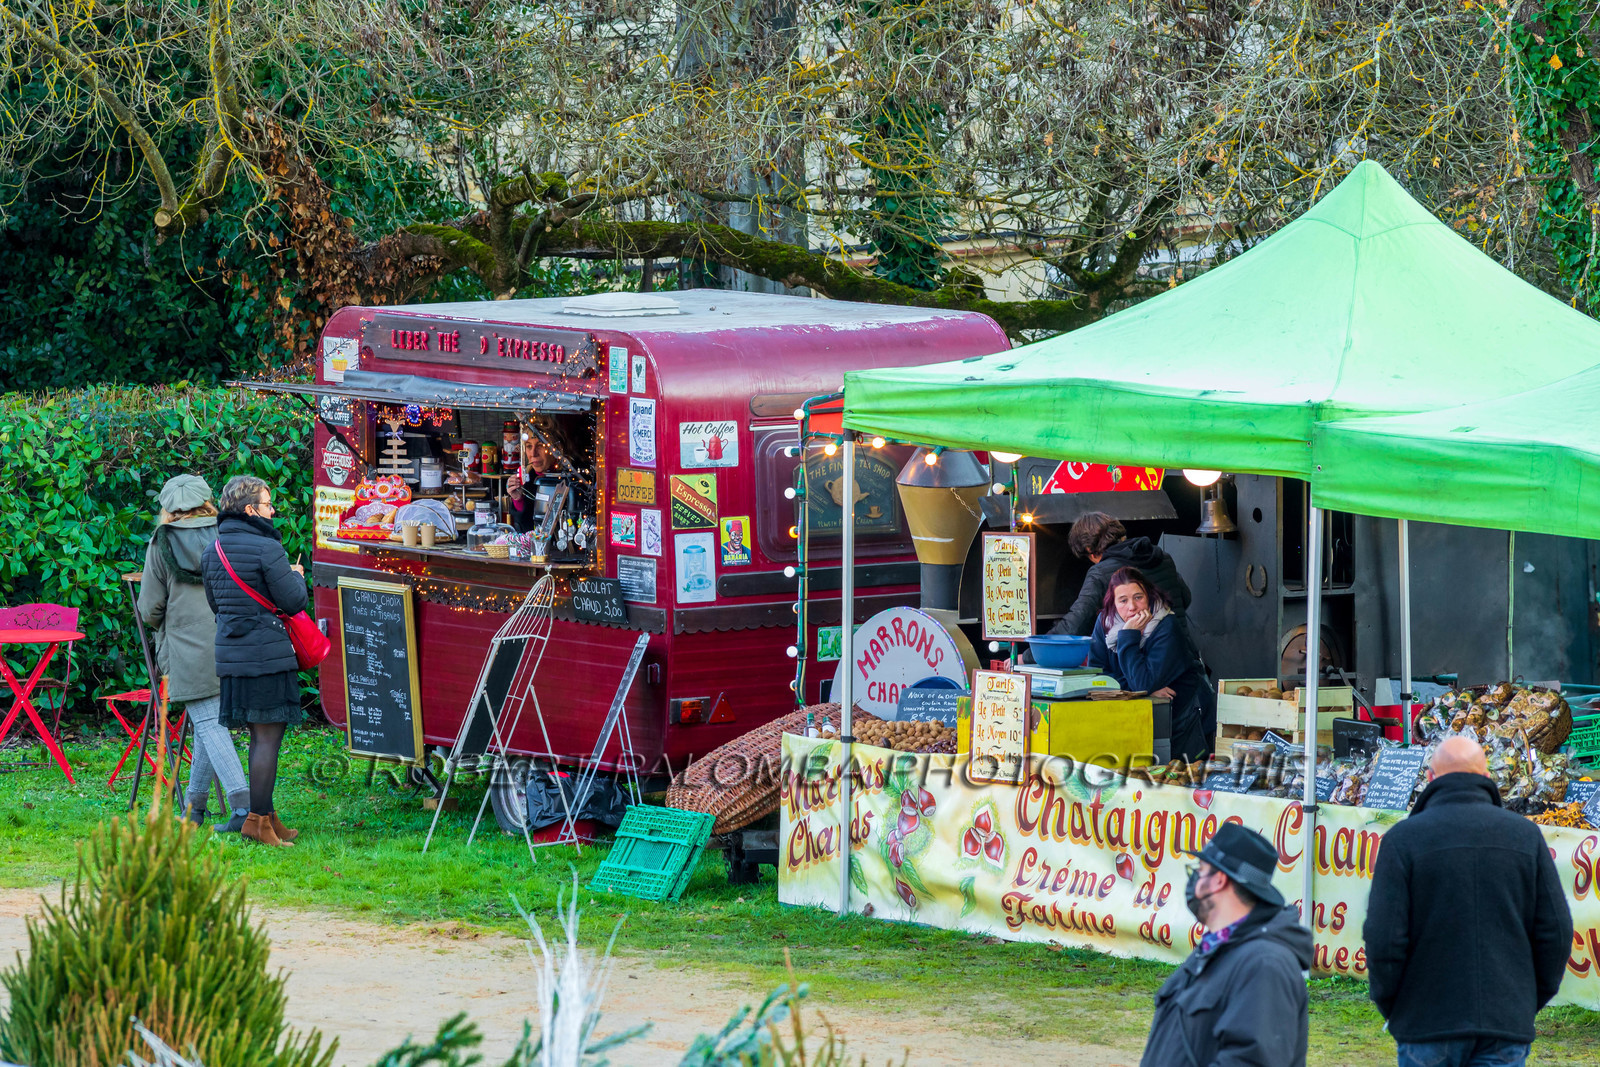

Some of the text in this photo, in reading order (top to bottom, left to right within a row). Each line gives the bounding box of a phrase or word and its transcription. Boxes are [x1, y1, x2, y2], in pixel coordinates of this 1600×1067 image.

[683, 422, 735, 439] Hot Coffee
[809, 466, 826, 480] THE
[873, 464, 890, 478] SHOP
[619, 485, 653, 501] COFFEE
[675, 483, 713, 515] Espresso
[673, 503, 701, 524] SERVED
[994, 539, 1019, 554] Tarifs
[998, 564, 1012, 580] Petit
[570, 578, 613, 594] CHOCOLAT
[996, 586, 1015, 603] Moyen
[354, 590, 378, 604] GRAND
[573, 596, 601, 615] CHAUD
[998, 608, 1015, 623] Grand
[987, 677, 1015, 694] Tarifs
[991, 703, 1006, 720] Petit
[987, 725, 1007, 744] Moyen
[1133, 871, 1172, 911] de
[1000, 891, 1117, 938] Farine
[1138, 912, 1174, 949] de
